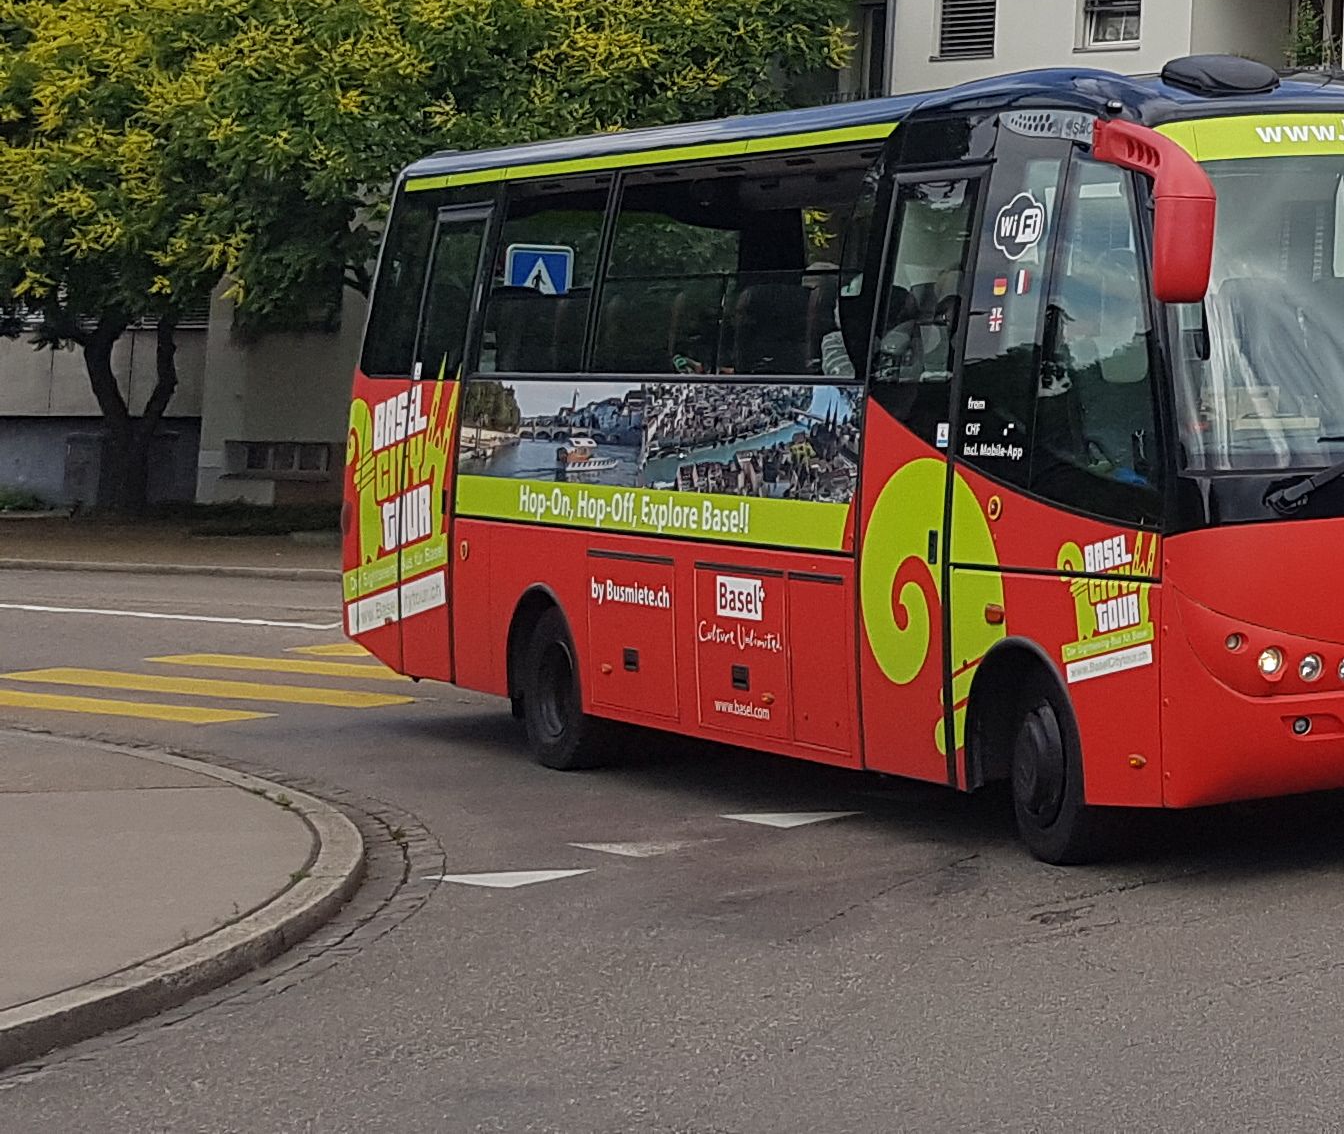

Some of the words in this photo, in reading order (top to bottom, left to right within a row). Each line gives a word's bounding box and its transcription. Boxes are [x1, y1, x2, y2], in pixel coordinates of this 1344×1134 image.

[373, 383, 428, 452] BASEL
[965, 423, 981, 436] CHF
[979, 443, 1023, 461] Mobile-App
[519, 485, 575, 521] Hop-On,
[577, 490, 638, 528] Hop-Off,
[641, 495, 699, 533] Explore
[1084, 534, 1133, 573] BASEL
[591, 577, 604, 604] by
[606, 579, 671, 608] Busmiete.ch
[698, 620, 736, 646] Culture
[713, 698, 771, 721] www.basel.com
